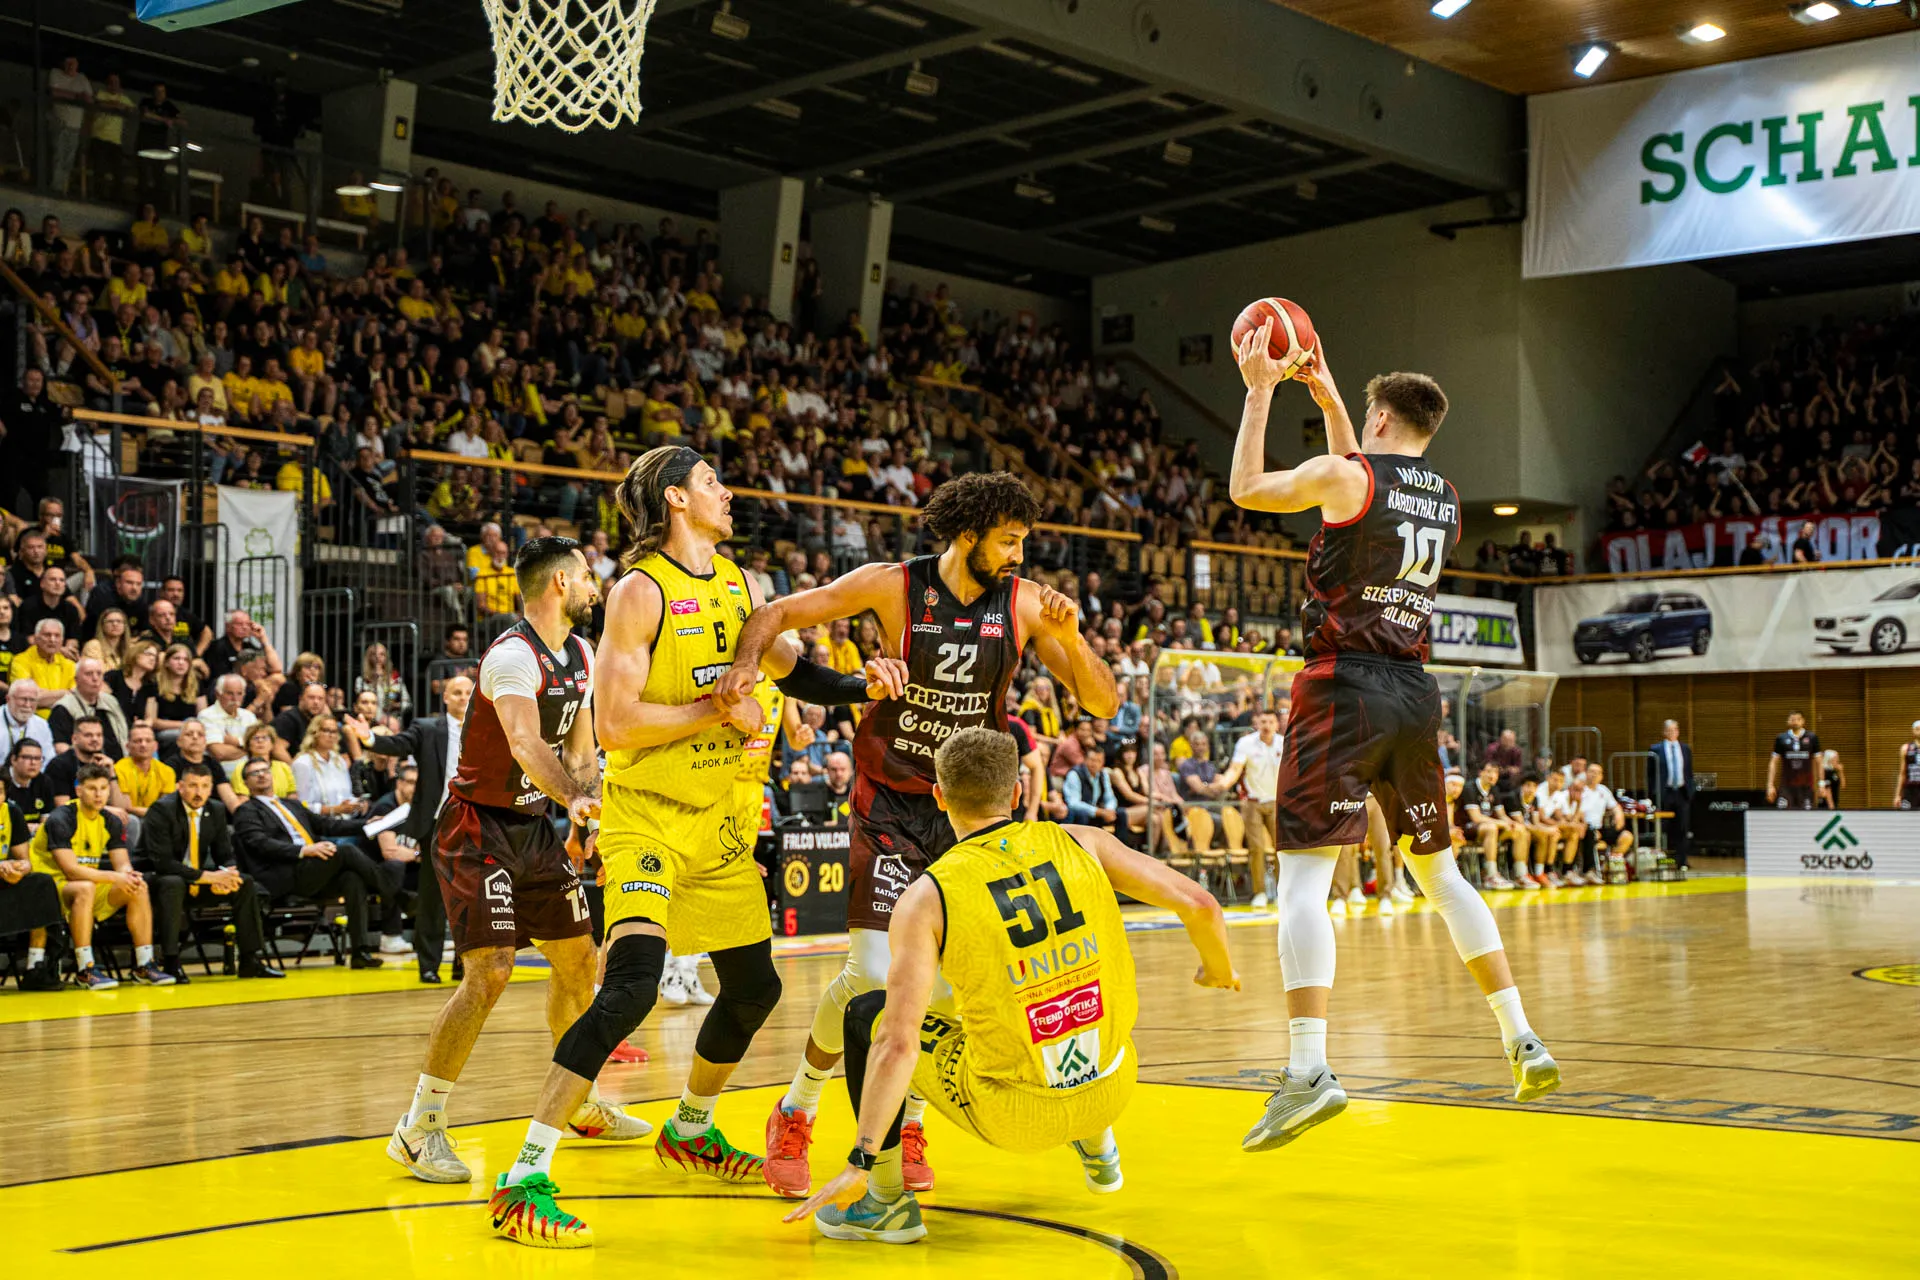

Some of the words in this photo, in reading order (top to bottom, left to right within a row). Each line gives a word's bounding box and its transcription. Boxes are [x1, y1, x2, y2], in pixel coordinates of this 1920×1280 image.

[1395, 521, 1446, 588] 10
[713, 620, 728, 653] 6
[934, 643, 978, 684] 22
[556, 701, 579, 736] 13
[691, 757, 721, 769] ALPOK
[783, 832, 814, 850] FALCO
[622, 881, 671, 901] TiPPMIX
[819, 862, 844, 893] 20
[565, 885, 590, 922] 13
[986, 861, 1086, 949] 51
[1007, 933, 1099, 986] UNION
[1016, 991, 1043, 1004] VIENNA
[1044, 975, 1081, 997] INSURANCE
[1033, 1010, 1064, 1027] TREND
[1064, 997, 1098, 1016] OPTIKA
